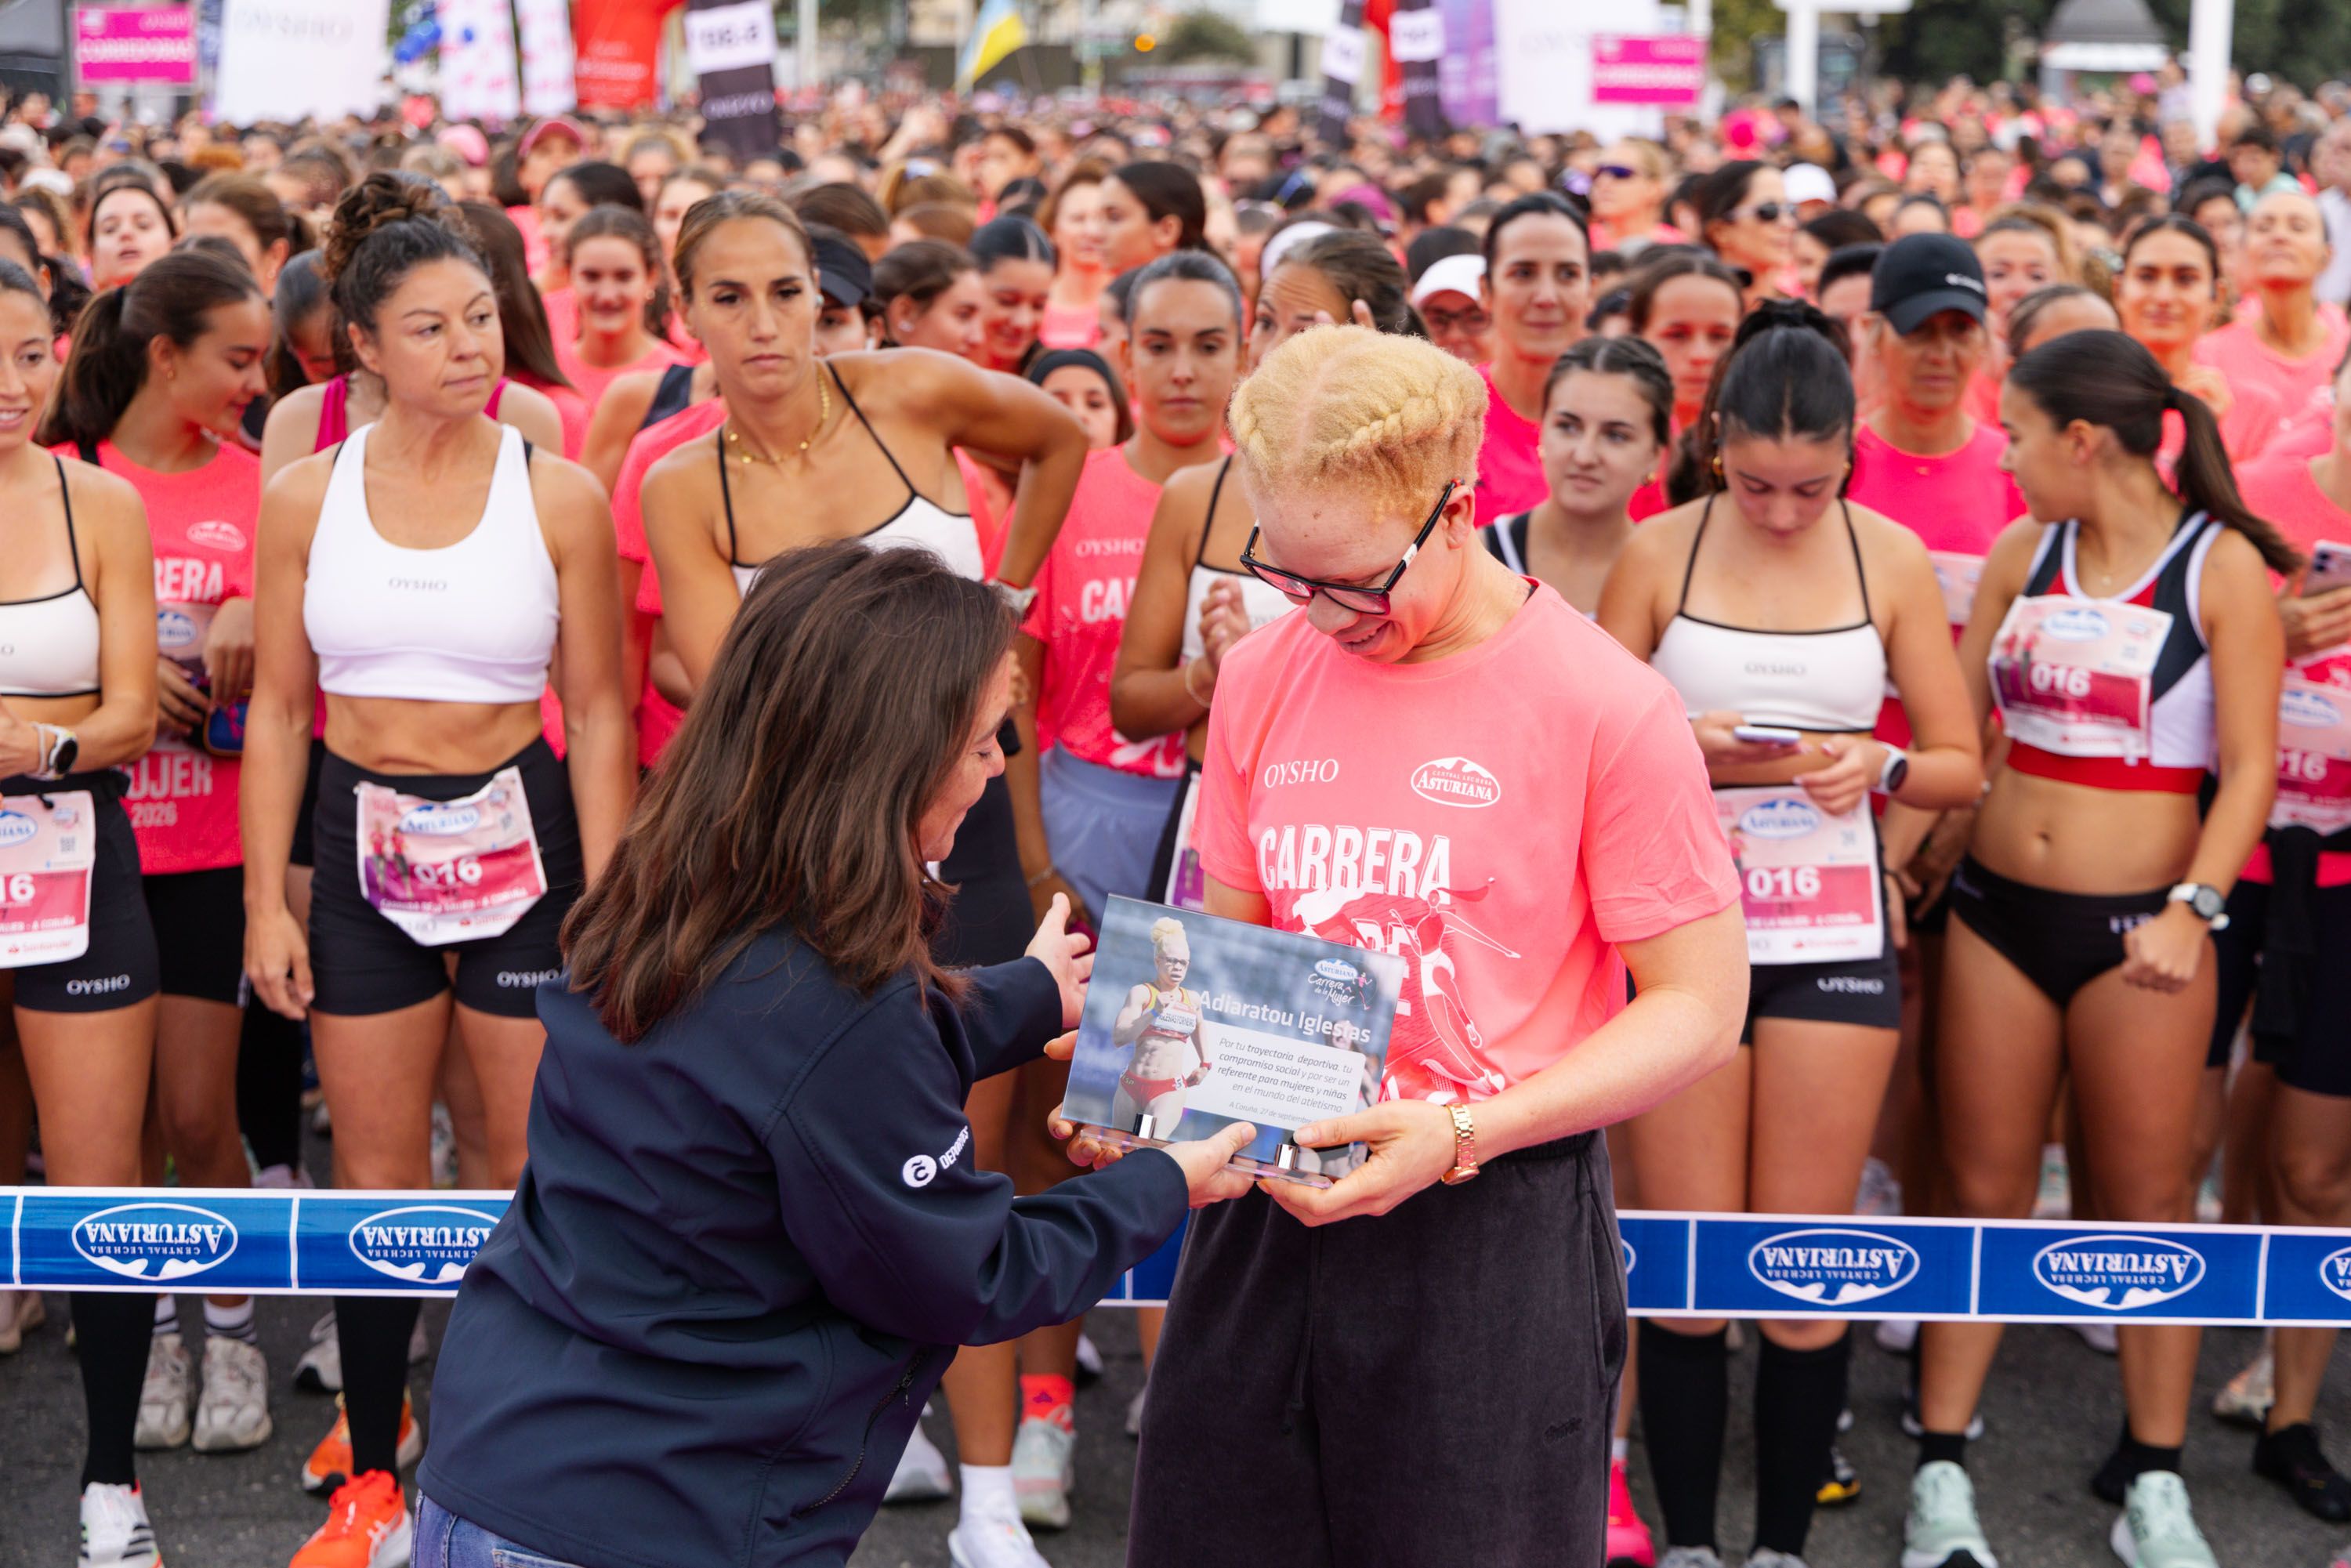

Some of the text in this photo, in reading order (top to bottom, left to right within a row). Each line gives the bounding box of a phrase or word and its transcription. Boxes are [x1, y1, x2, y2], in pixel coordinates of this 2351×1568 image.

[2030, 664, 2092, 697] 016
[1264, 759, 1339, 788] OYSHO
[1416, 770, 1493, 801] ASTURIANA
[1433, 770, 1491, 786] CENTRAL LECHERA
[131, 801, 178, 827] 2026
[414, 855, 483, 887] 016
[1259, 824, 1450, 904] CARRERA
[1748, 867, 1820, 898] 016
[67, 974, 130, 995] OYSHO
[1307, 973, 1344, 990] Carrera
[1320, 964, 1355, 978] ASTURIANA
[1817, 977, 1884, 994] OYSHO
[1325, 987, 1355, 1006] Mujer
[1200, 990, 1371, 1043] Adiaratou Iglesias
[1219, 1037, 1353, 1074] Por tu trayectoria deportiva, tu
[1219, 1052, 1273, 1071] compromiso
[1274, 1064, 1301, 1076] social
[1301, 1070, 1307, 1079] y
[1306, 1072, 1323, 1081] por
[1324, 1075, 1337, 1084] ser
[1217, 1066, 1347, 1100] referente para mujeres y niñas
[1232, 1083, 1243, 1092] en
[1244, 1085, 1252, 1094] el
[1254, 1088, 1285, 1101] mundo
[1286, 1093, 1302, 1103] del
[85, 1223, 226, 1255] ASTURIANA
[90, 1246, 201, 1255] CENTRAL LECHERA
[368, 1249, 421, 1259] LECHERA
[1762, 1247, 1908, 1279] ASTURIANA
[2046, 1252, 2194, 1284] ASTURIANA
[1766, 1269, 1880, 1280] CENTRAL LECHERA
[2051, 1274, 2166, 1284] CENTRAL LECHERA
